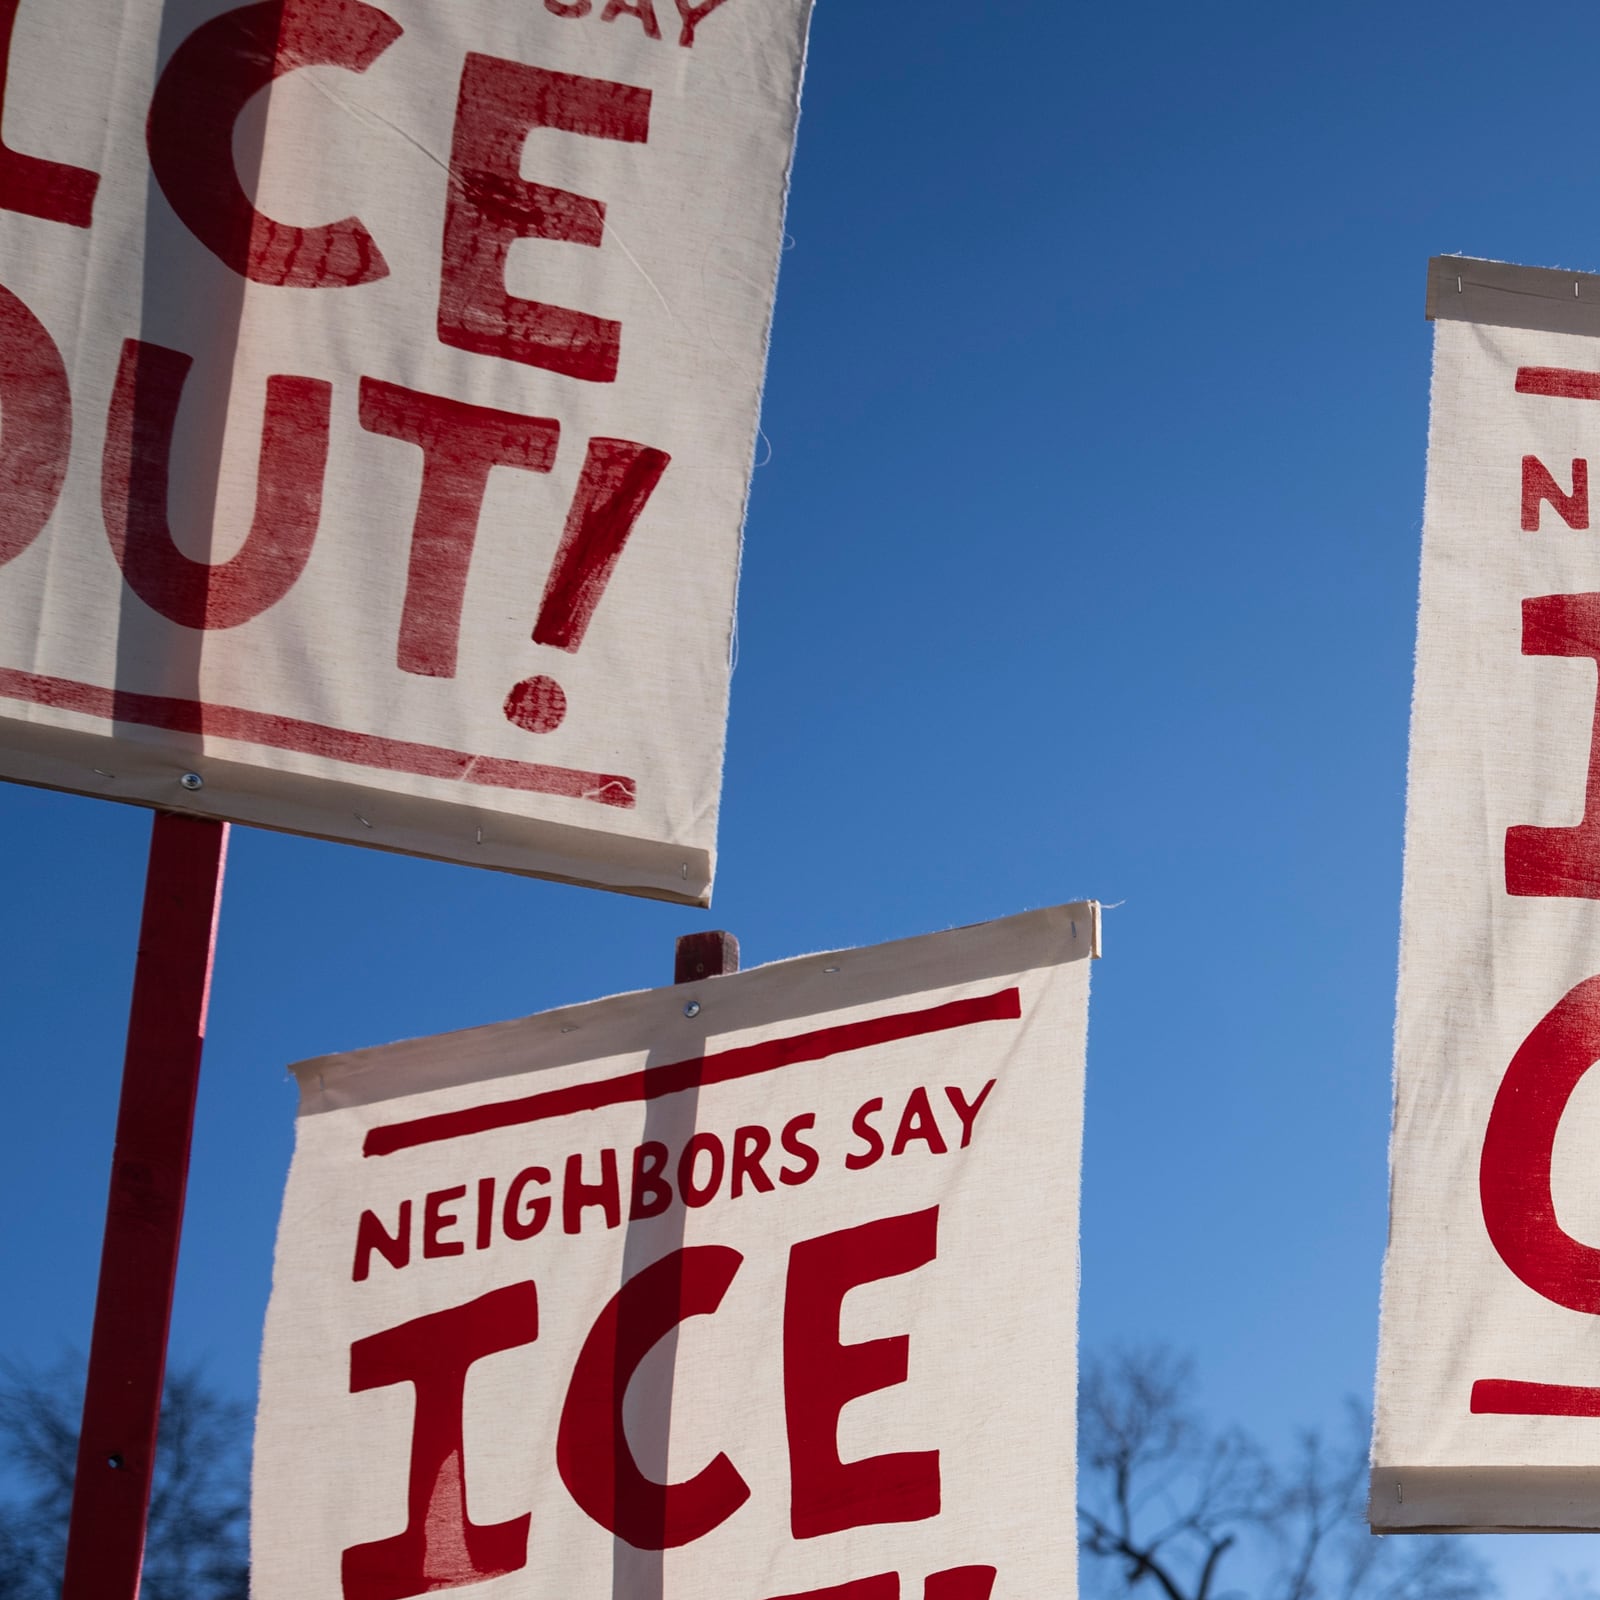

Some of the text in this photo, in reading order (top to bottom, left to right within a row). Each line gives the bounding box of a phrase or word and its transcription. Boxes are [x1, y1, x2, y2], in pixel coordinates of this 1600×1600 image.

[0, 0, 655, 384] CE
[0, 283, 671, 735] UT!
[352, 1078, 997, 1282] NEIGHBORS SAY
